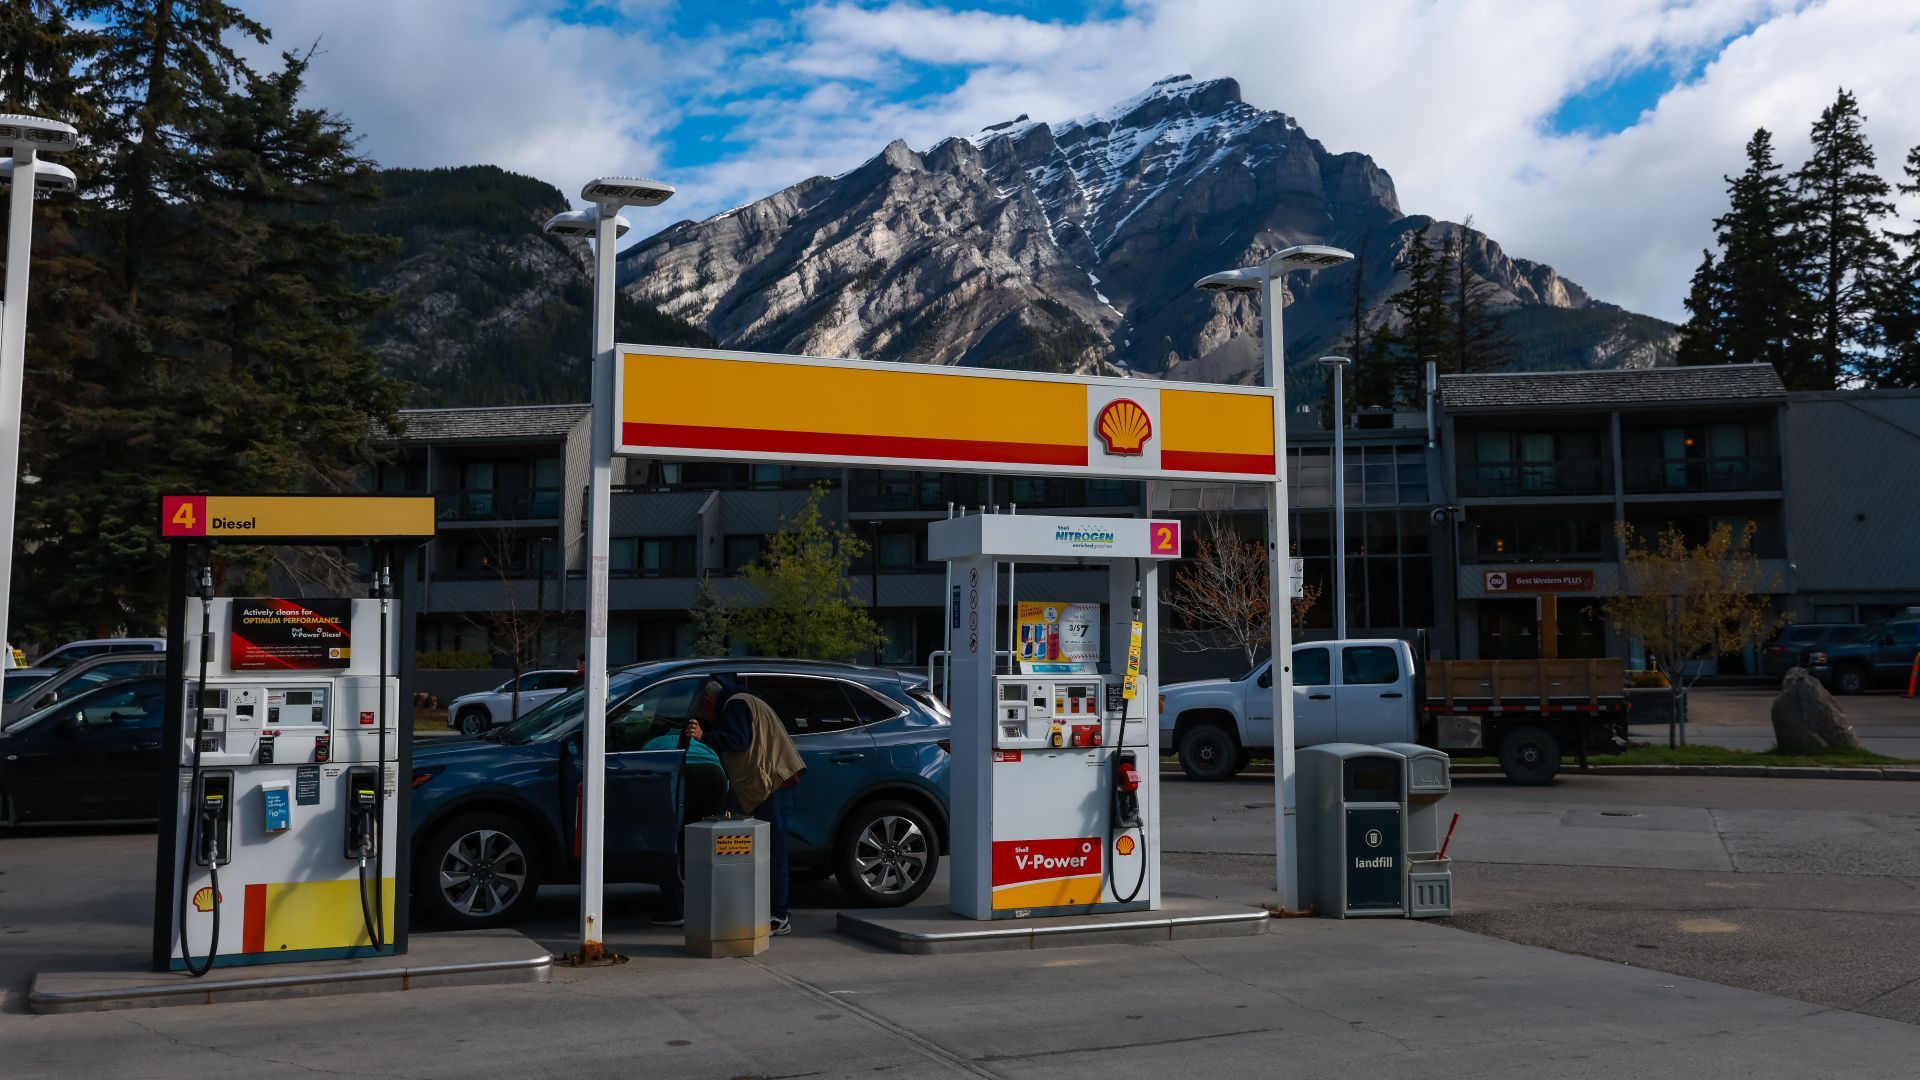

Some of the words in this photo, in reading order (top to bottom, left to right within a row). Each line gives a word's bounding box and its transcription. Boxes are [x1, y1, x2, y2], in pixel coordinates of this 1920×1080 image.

[172, 503, 197, 529] 4
[212, 517, 256, 529] Diesel
[1055, 531, 1114, 541] NITROGEN
[1157, 527, 1173, 550] 2
[1516, 577, 1532, 585] Best
[1533, 577, 1562, 585] Western
[1563, 577, 1583, 585] PLUS
[243, 608, 274, 618] Actively
[275, 608, 300, 616] cleans
[301, 608, 313, 616] for
[243, 617, 281, 625] OPTIMUM
[283, 616, 342, 625] PERFORMANCE.
[1015, 853, 1088, 871] V-Power
[1355, 856, 1393, 869] landfill
